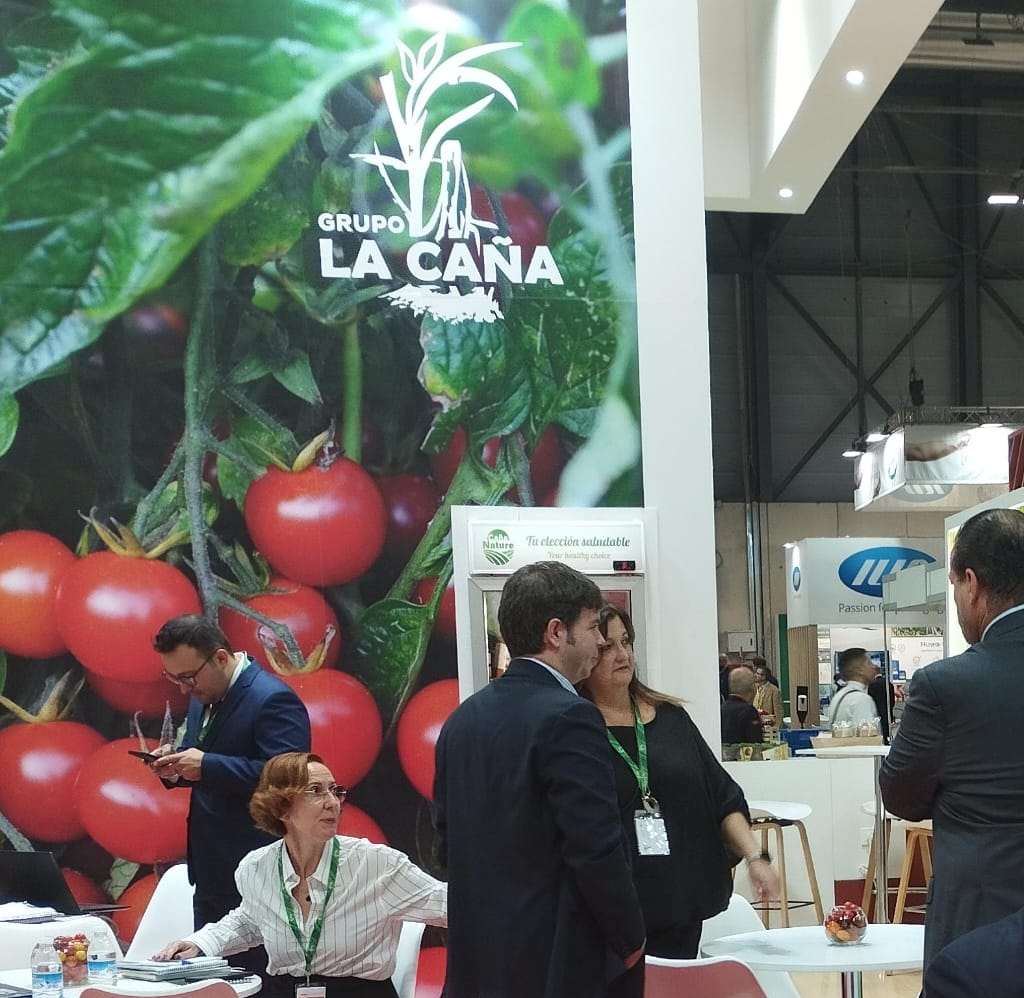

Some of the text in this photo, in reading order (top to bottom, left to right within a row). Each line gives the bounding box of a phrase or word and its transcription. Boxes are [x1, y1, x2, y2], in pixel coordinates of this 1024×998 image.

[318, 213, 405, 233] GRUPO
[319, 236, 564, 285] LA CAÑA
[483, 540, 514, 549] Nature
[526, 535, 630, 547] Tu elección saludable
[564, 551, 589, 560] healthy
[590, 551, 611, 559] choice
[839, 602, 876, 613] Passion
